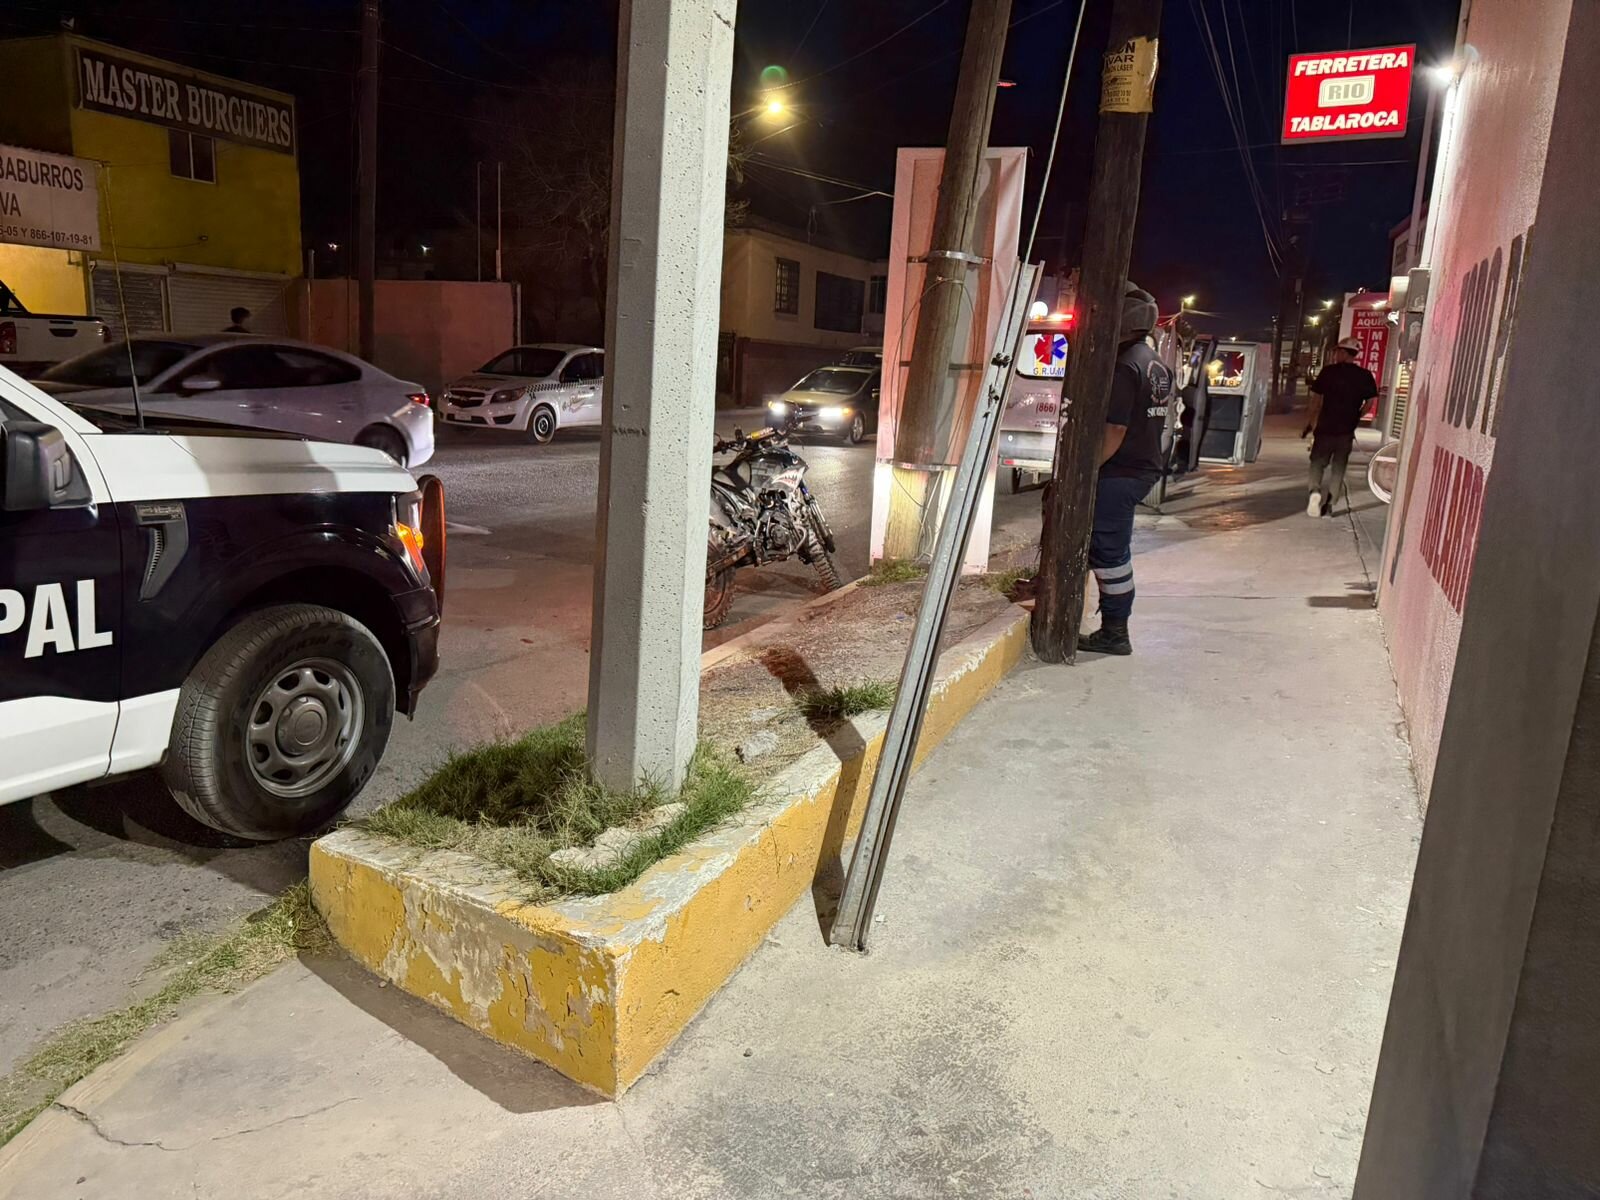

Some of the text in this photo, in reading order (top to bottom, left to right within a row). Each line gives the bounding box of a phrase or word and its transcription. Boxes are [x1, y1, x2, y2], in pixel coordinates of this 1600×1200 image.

[1294, 51, 1408, 77] FERRETERA
[83, 57, 291, 147] MASTER BURGUERS
[1327, 82, 1365, 101] RIO
[1290, 109, 1399, 133] TABLAROCA
[21, 227, 27, 238] Y
[30, 228, 93, 245] 866-107-19-81
[1442, 246, 1502, 429] TODO
[1035, 402, 1057, 415] (866)
[0, 578, 114, 659] PAL
